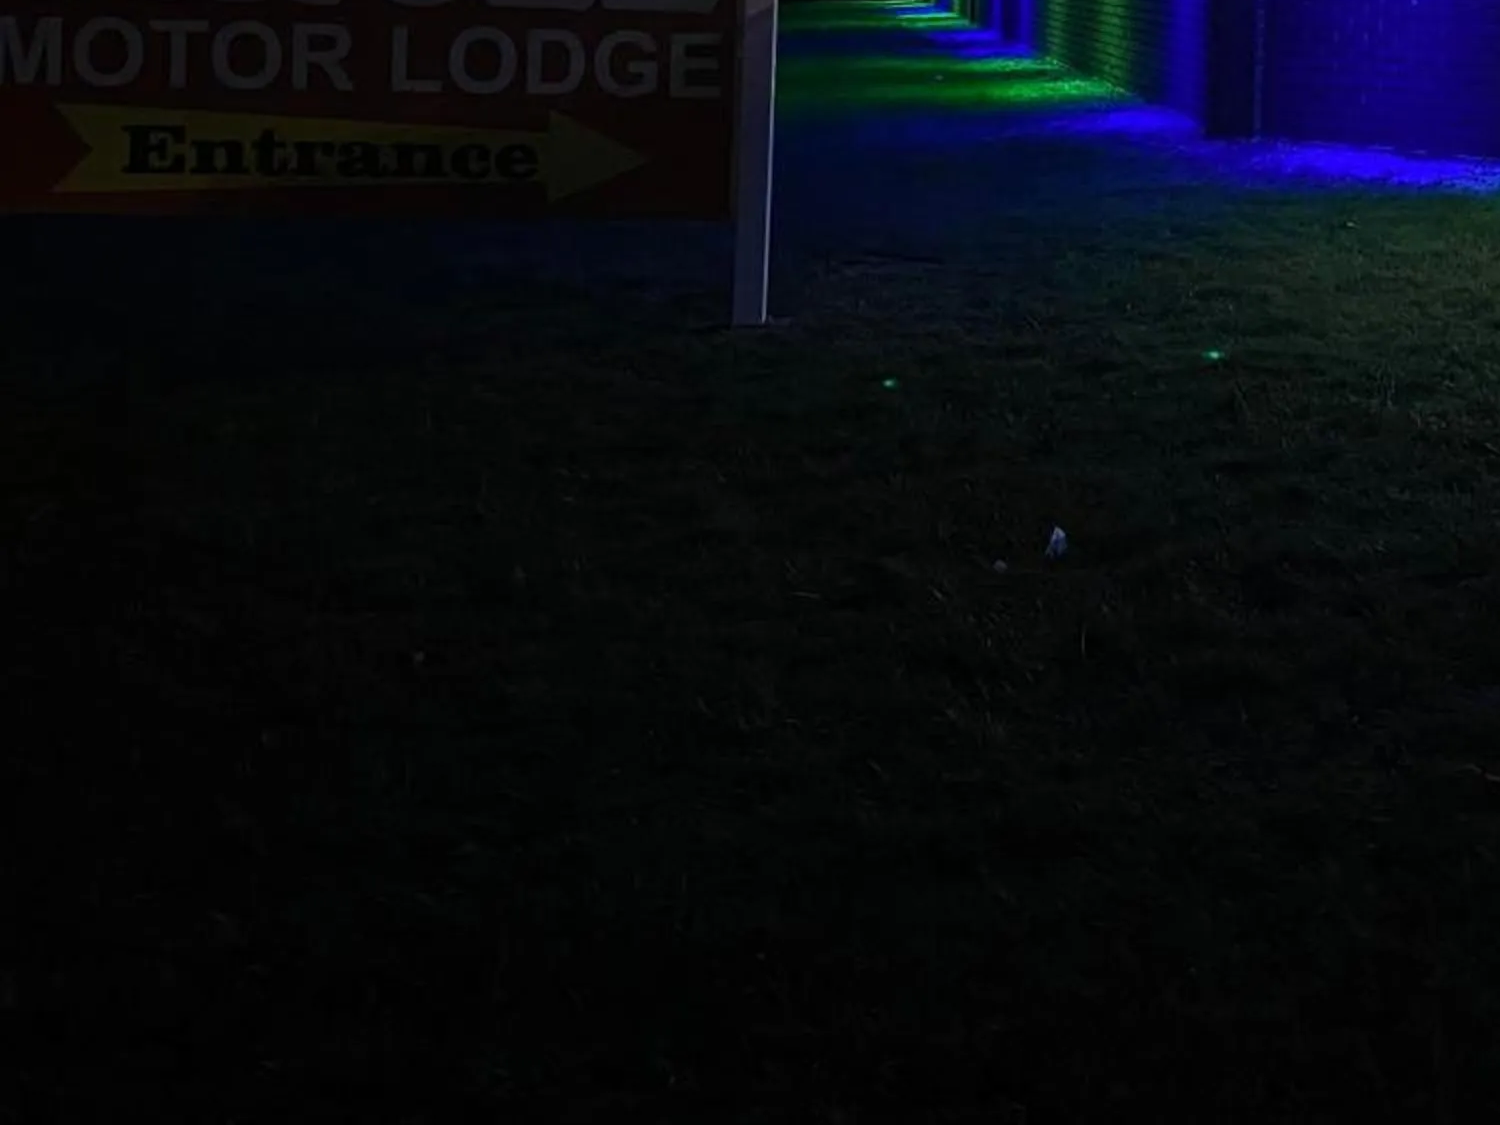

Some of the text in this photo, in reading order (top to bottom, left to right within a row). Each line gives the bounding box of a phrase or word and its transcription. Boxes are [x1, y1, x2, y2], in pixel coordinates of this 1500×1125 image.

[0, 15, 723, 100] MOTOR LODGE
[121, 124, 540, 179] Entrance
